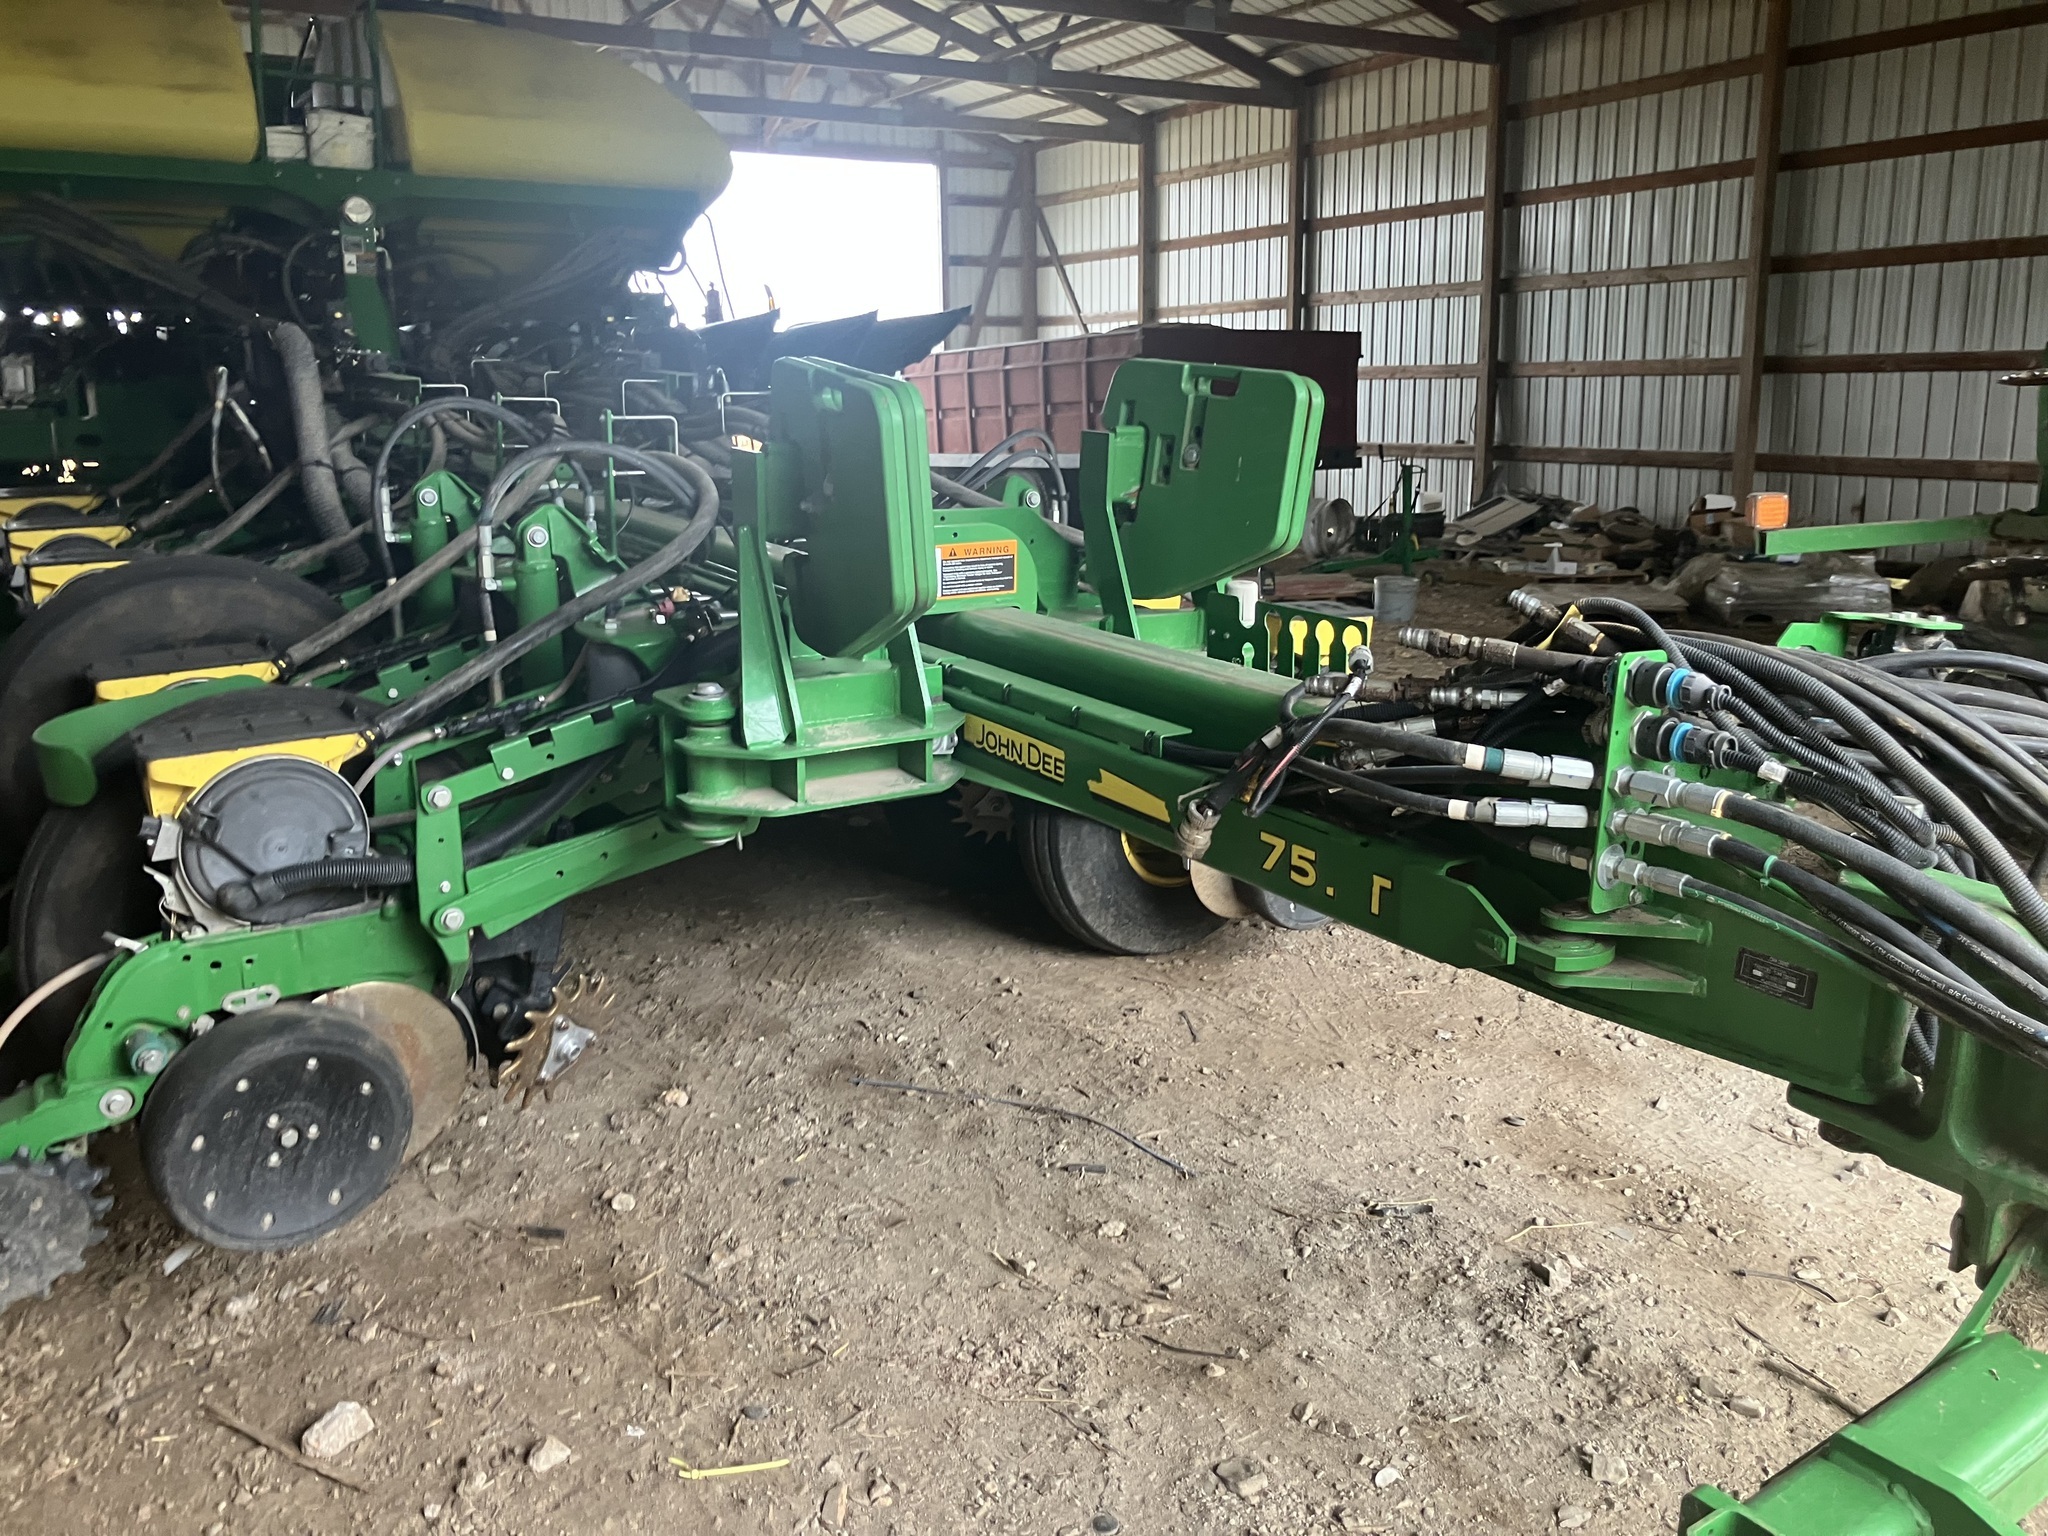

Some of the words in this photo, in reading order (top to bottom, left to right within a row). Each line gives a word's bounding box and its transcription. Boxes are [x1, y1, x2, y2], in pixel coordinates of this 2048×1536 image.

[964, 546, 1010, 556] WARNING
[976, 724, 1023, 762] JOHN
[1027, 742, 1064, 779] DEE
[2000, 1013, 2017, 1027] MPa
[2016, 1021, 2036, 1035] 22.5
